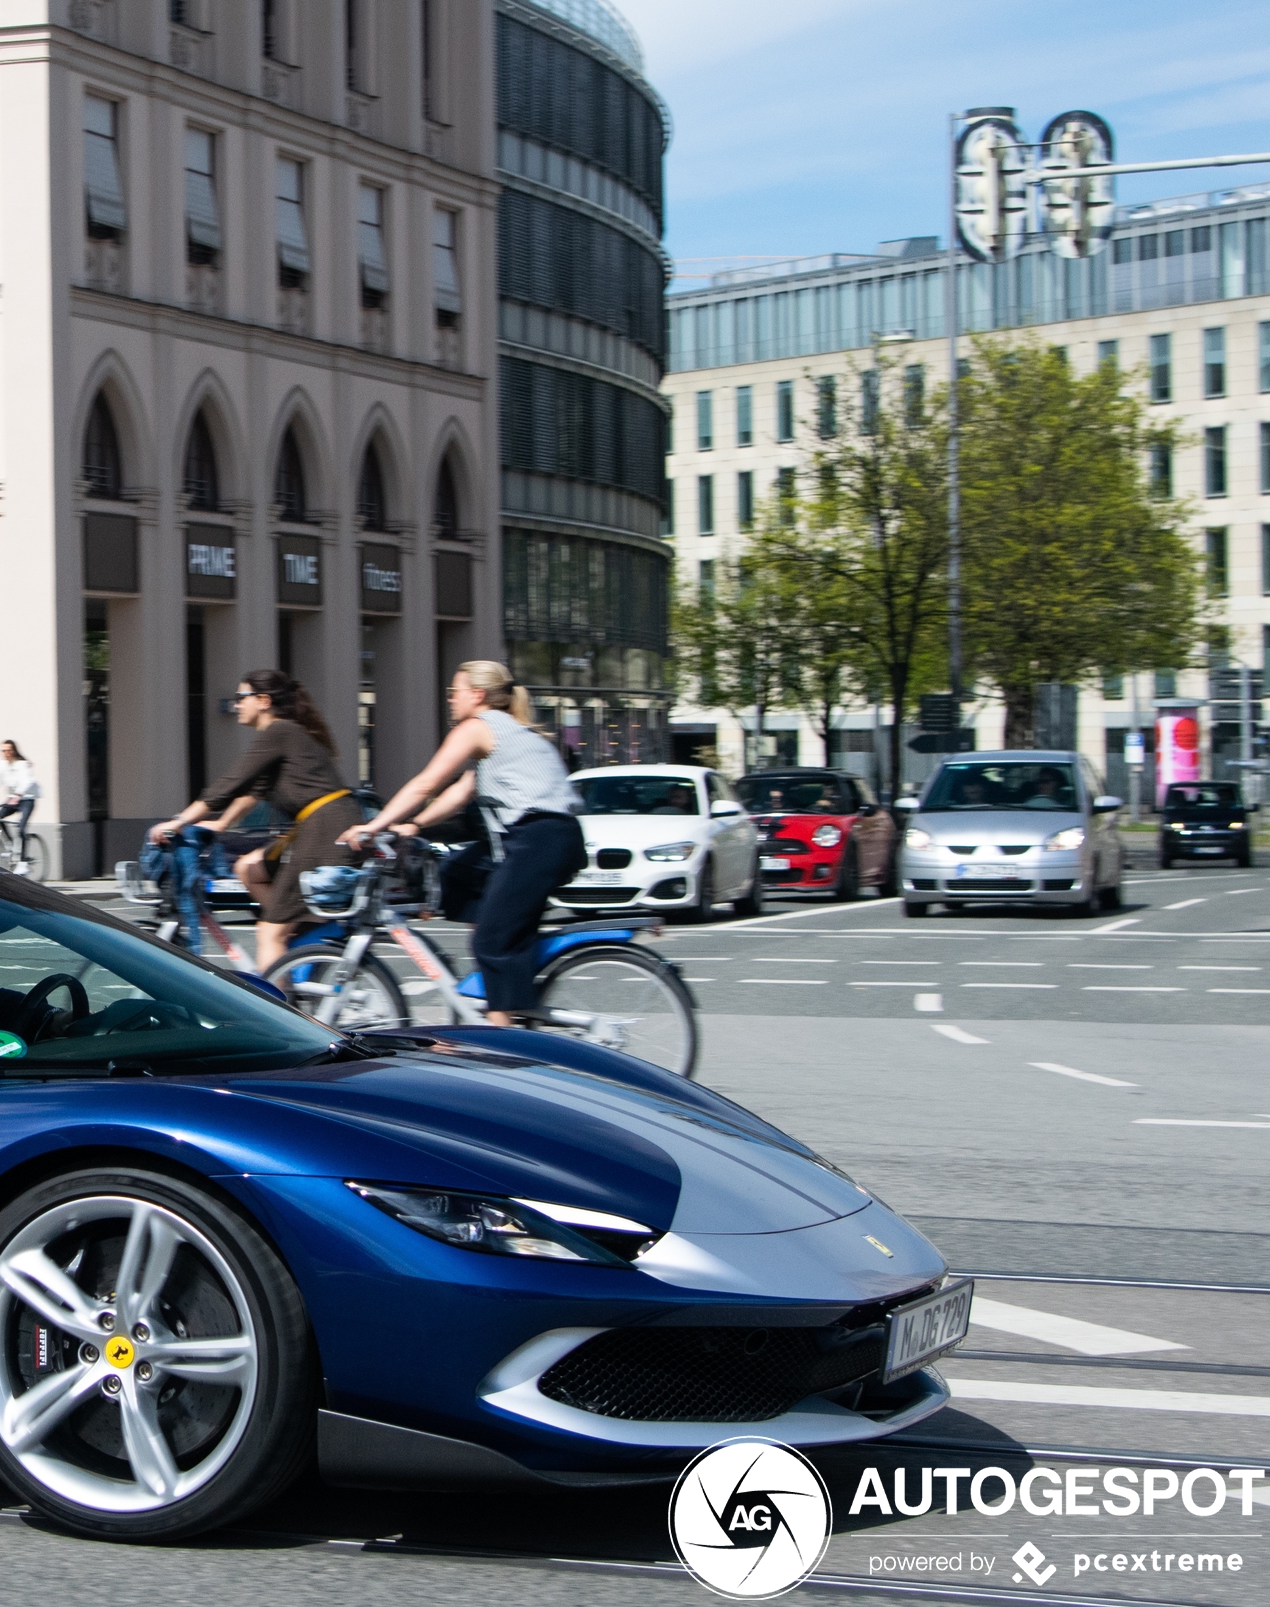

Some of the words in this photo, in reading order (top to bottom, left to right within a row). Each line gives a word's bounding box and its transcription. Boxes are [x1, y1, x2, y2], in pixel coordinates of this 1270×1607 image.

[188, 544, 237, 578] PRIME
[283, 554, 319, 585] TIME
[363, 562, 402, 592] fitness
[39, 1328, 48, 1366] Ferrari
[900, 1315, 915, 1361] M
[919, 1304, 941, 1352] DG
[939, 1292, 966, 1342] 729
